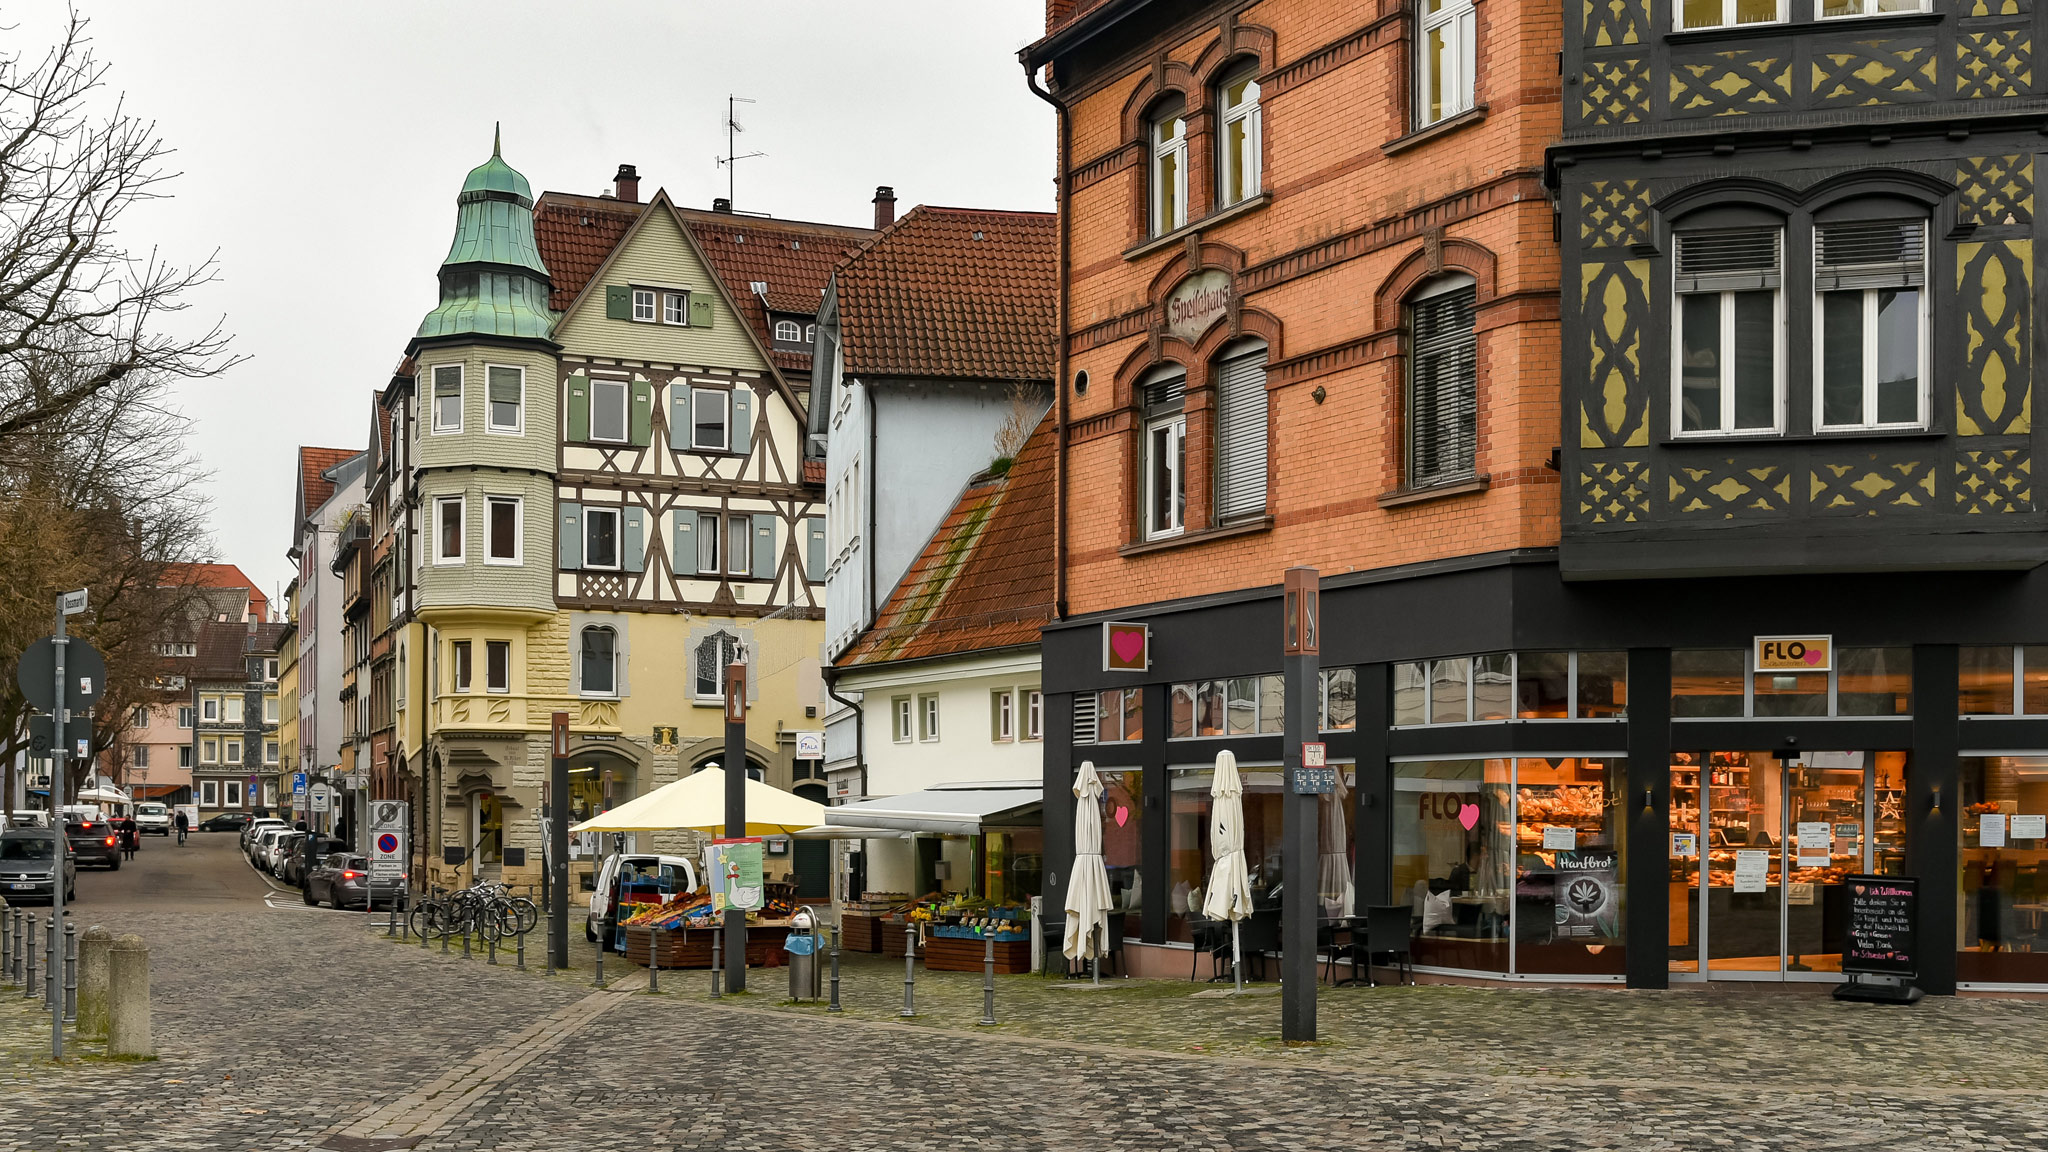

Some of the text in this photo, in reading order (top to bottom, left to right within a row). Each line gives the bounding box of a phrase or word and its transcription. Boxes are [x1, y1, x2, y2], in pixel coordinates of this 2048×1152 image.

[1764, 641, 1806, 660] FLO
[1419, 791, 1462, 820] FLO
[1560, 855, 1613, 870] Hanfbrot
[1857, 939, 1874, 948] Vielen
